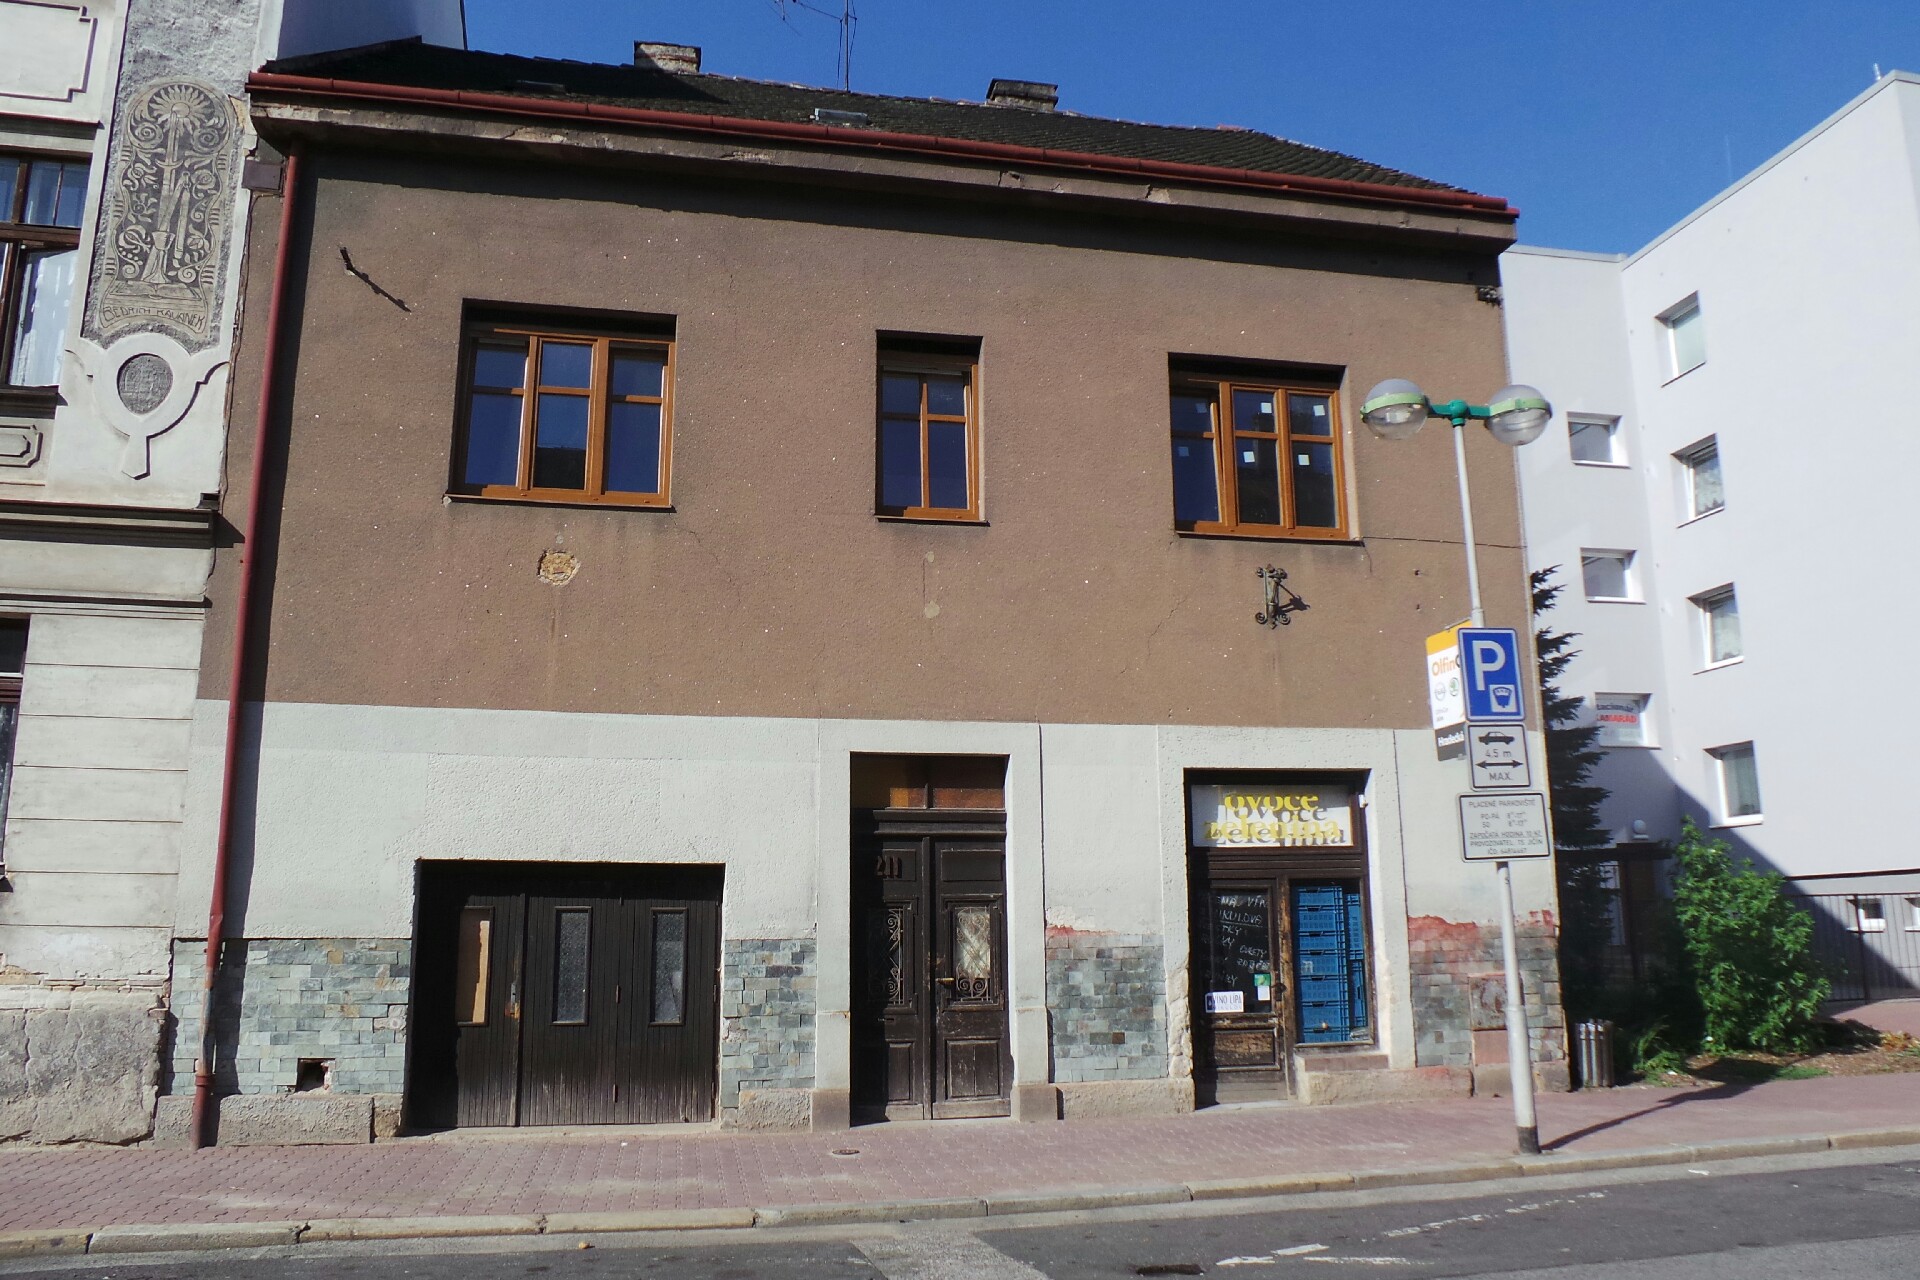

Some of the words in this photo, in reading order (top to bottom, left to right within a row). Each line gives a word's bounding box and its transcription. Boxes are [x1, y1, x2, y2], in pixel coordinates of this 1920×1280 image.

[1472, 640, 1506, 691] P
[1224, 794, 1319, 812] ovoce
[1204, 813, 1342, 840] zelenina
